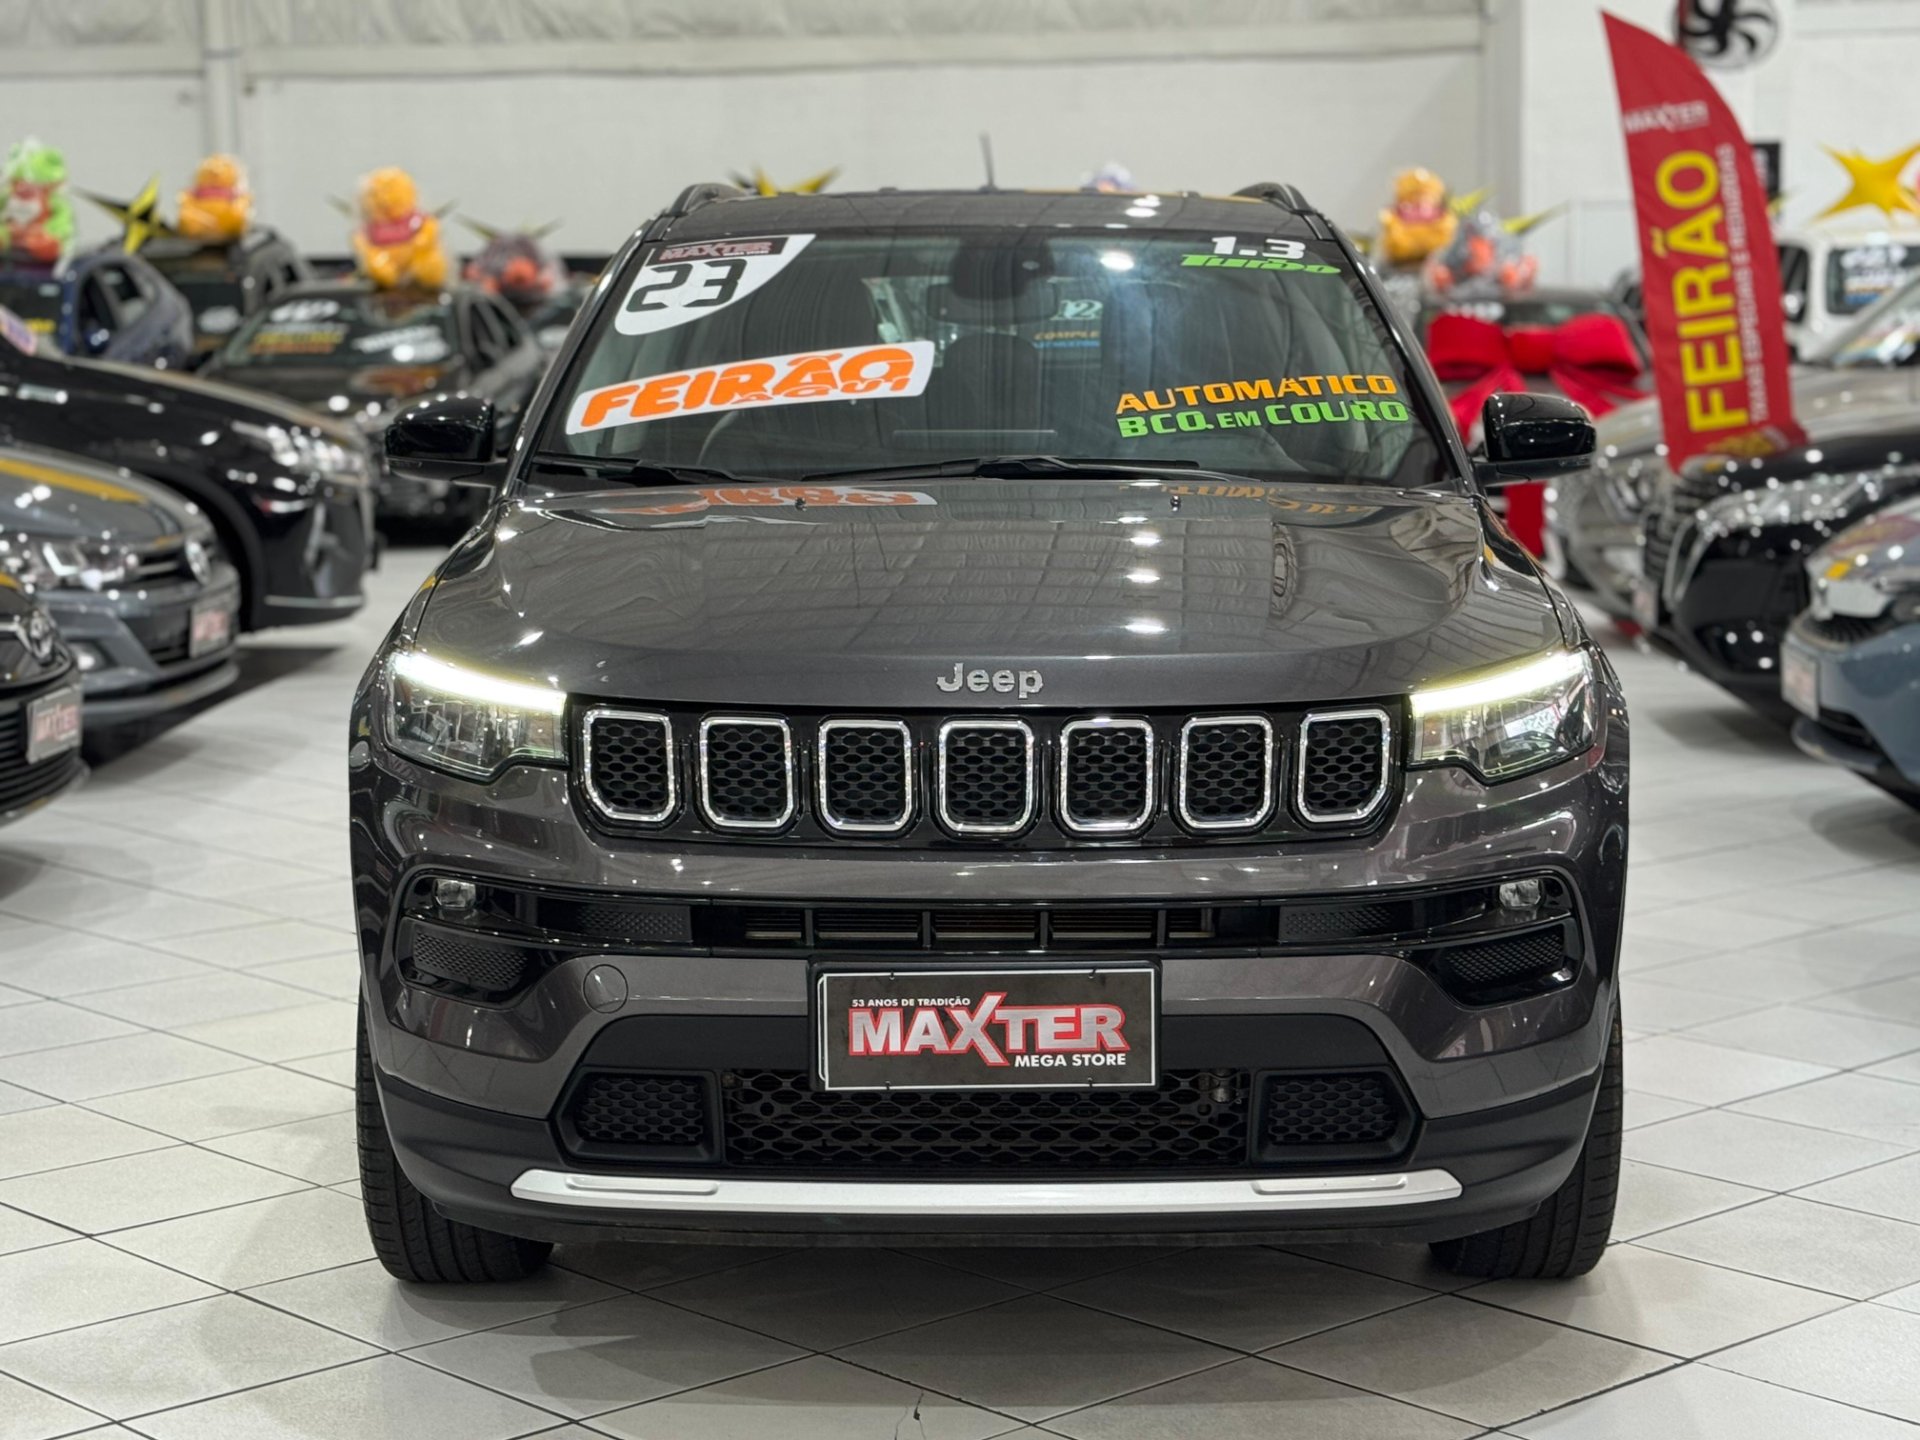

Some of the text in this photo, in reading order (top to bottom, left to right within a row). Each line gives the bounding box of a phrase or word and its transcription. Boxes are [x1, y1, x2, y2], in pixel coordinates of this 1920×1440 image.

[659, 241, 773, 260] MAXTER
[1211, 236, 1306, 259] 1.3
[626, 259, 748, 313] 23
[1651, 150, 1749, 432] FEIRÃO
[580, 348, 915, 427] FEIRÃO
[1216, 411, 1262, 429] EM
[1265, 401, 1409, 425] COURO
[936, 662, 1044, 700] Jeep
[852, 996, 971, 1008] 53 ANOS DE TRADIÇÃO
[849, 992, 1131, 1066] MAXTER
[1014, 1053, 1127, 1068] MEGA STORE
